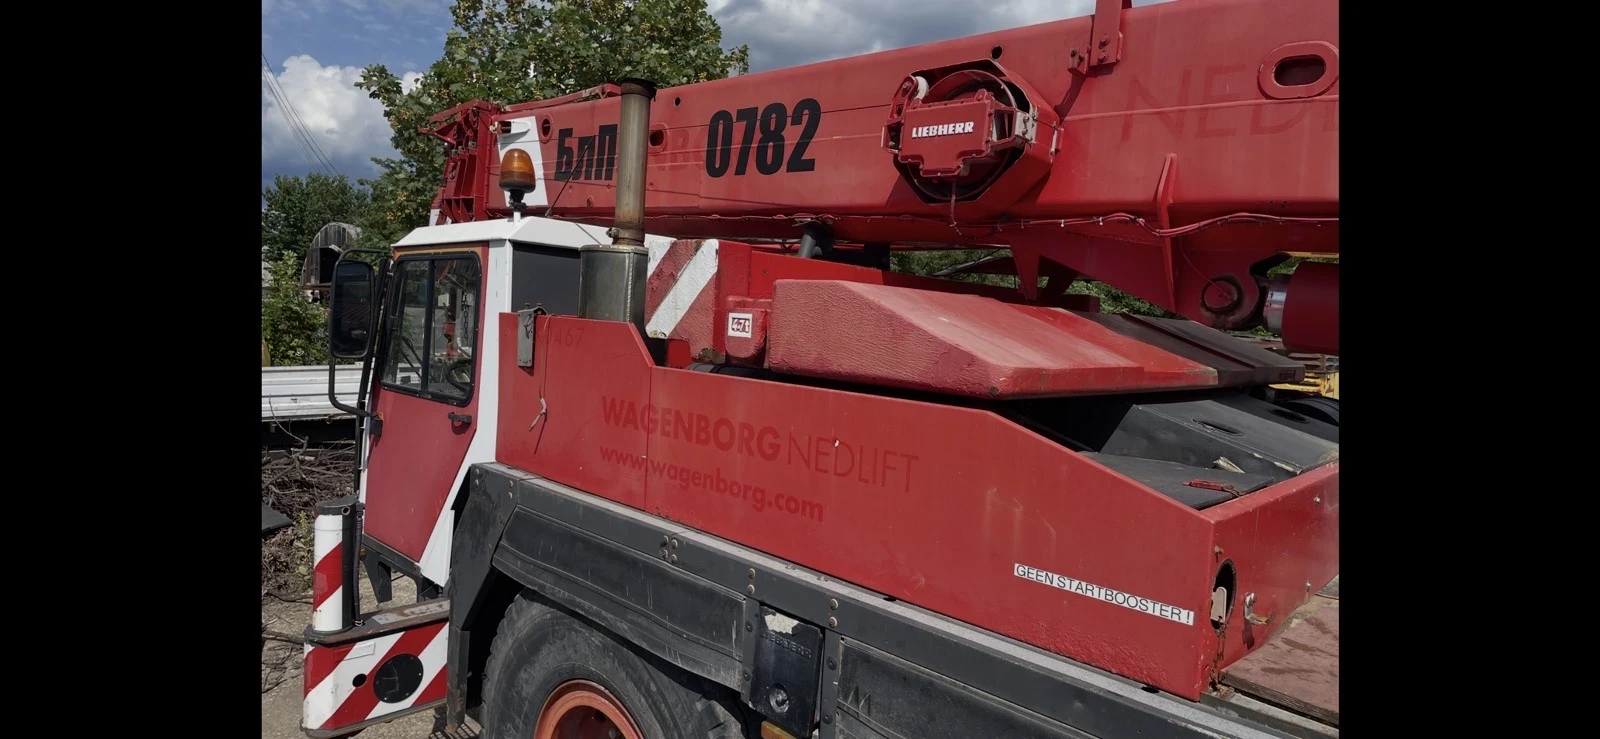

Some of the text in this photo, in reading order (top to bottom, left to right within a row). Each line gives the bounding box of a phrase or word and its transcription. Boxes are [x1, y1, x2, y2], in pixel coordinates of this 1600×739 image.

[705, 98, 821, 178] 0782
[911, 121, 975, 138] LIEBHERR
[601, 395, 920, 493] WAGENBORG NEDLIFT
[599, 446, 824, 522] www.wagenborg.com
[1016, 565, 1190, 624] GEEN STARTBOOSTER !
